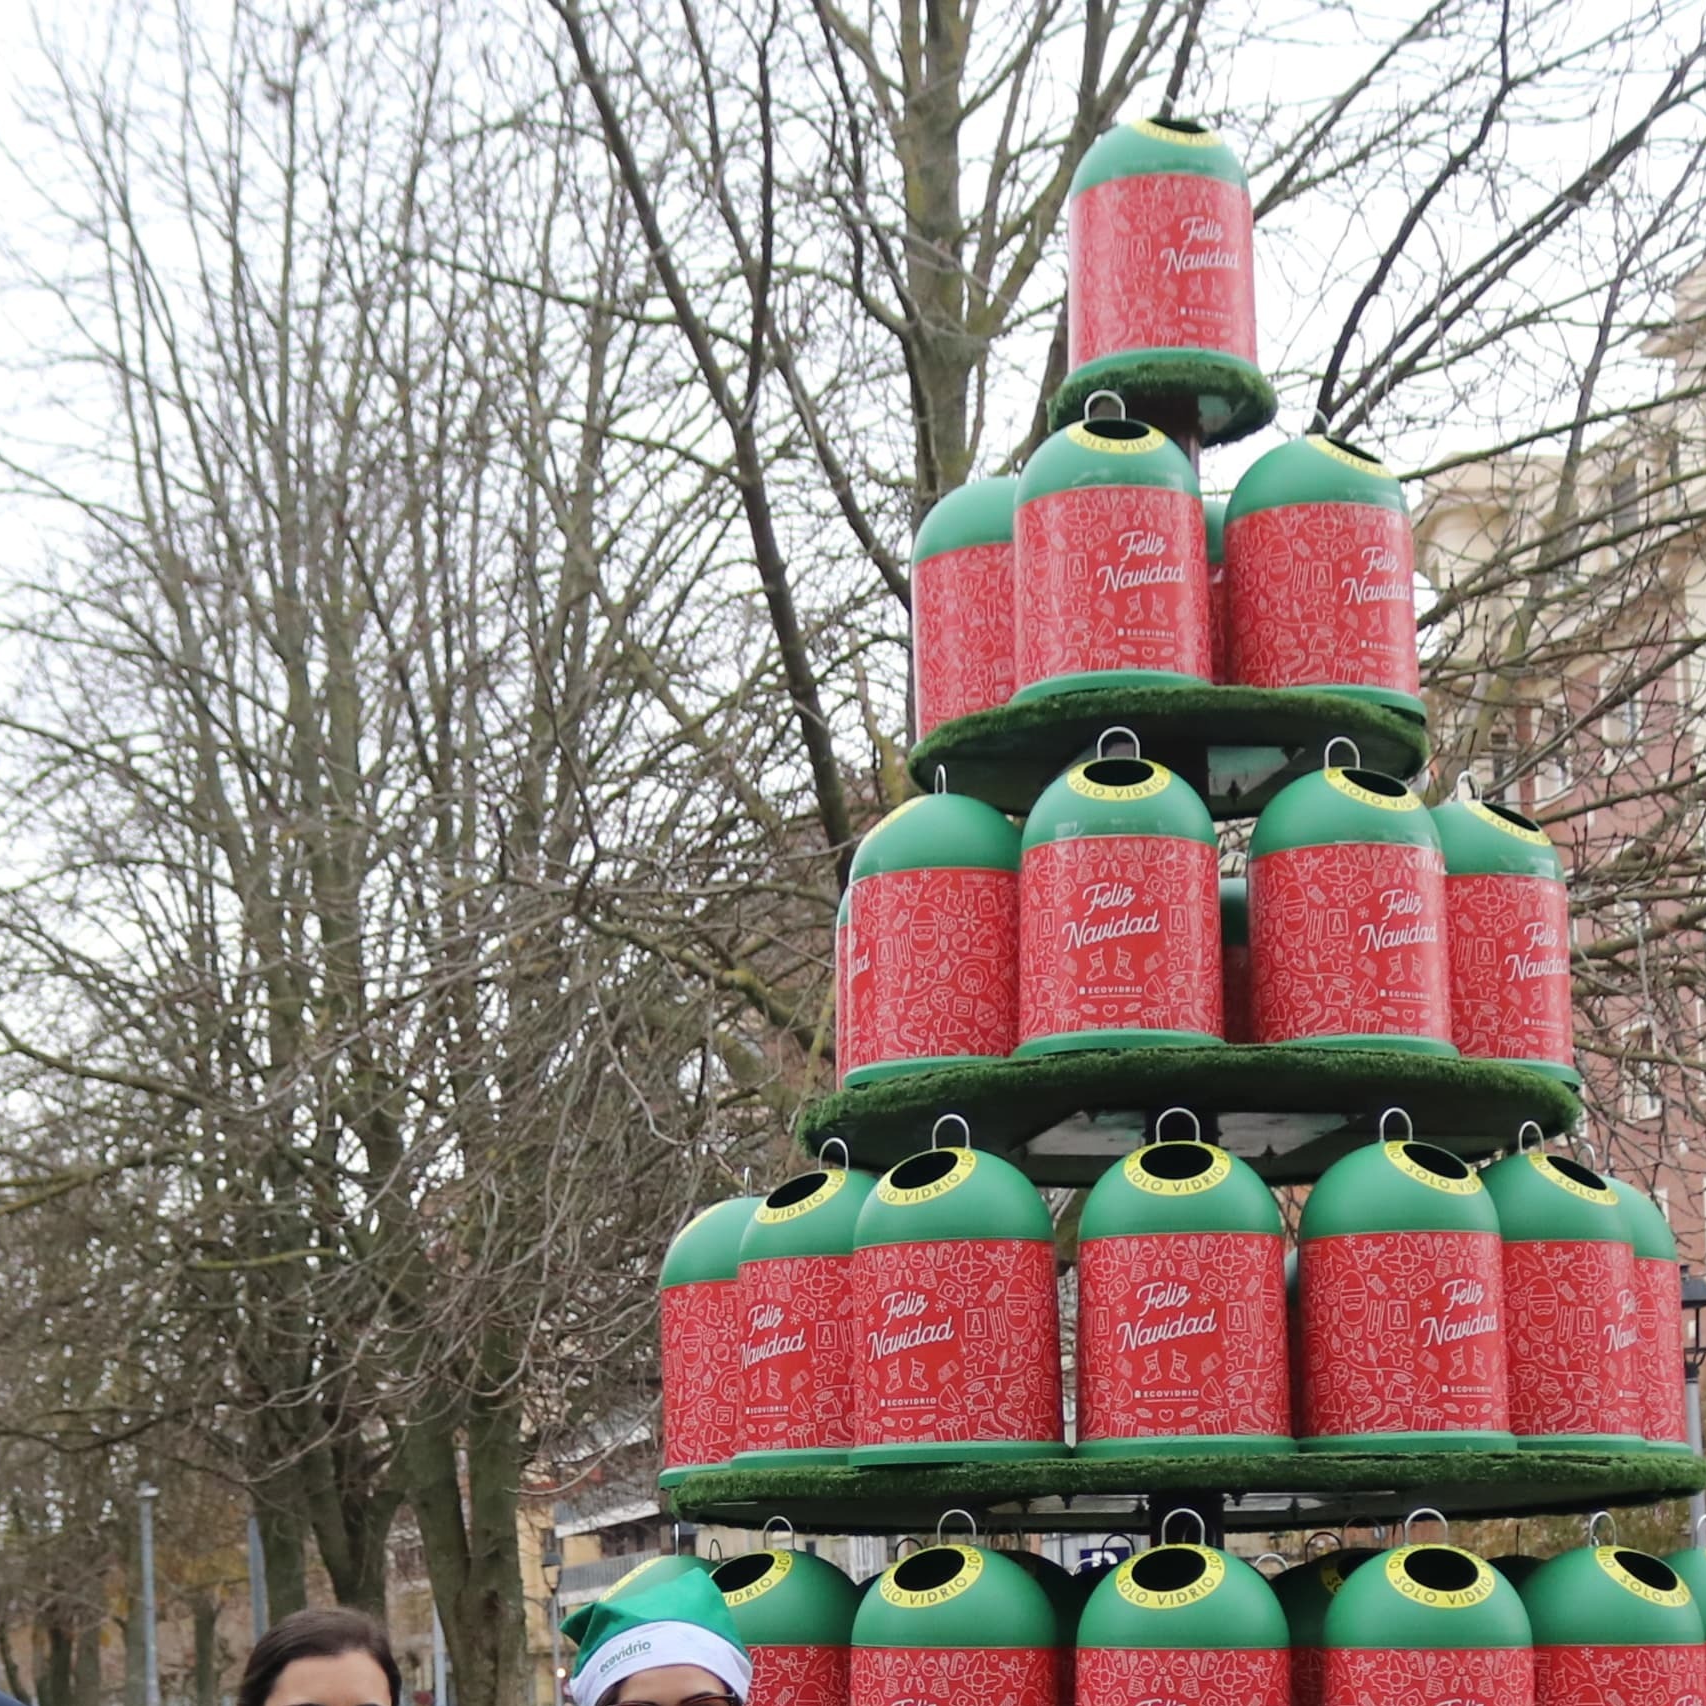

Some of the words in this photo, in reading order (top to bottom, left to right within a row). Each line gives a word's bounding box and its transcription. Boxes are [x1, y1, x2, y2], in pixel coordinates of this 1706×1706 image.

[1181, 216, 1223, 246] Feliz
[1160, 246, 1240, 275] Navidad
[1118, 530, 1166, 561] Feliz
[1361, 546, 1399, 574] Feliz
[1096, 560, 1185, 595] Navidad
[1342, 575, 1411, 605] Navidad
[1082, 882, 1135, 916] Feliz
[1379, 888, 1422, 921] Feliz
[1061, 910, 1160, 951] Navidad
[1358, 921, 1438, 953] Navidad
[1524, 922, 1558, 950] Feliz
[1088, 985, 1143, 994] ECOVIDRIO
[904, 1172, 961, 1203] VIDRIO
[1127, 1165, 1163, 1193] SOLO
[1172, 1164, 1225, 1193] VIDRIO
[1405, 1161, 1450, 1191] SOLO
[770, 1190, 824, 1222] VIDRIO
[881, 1290, 929, 1327] Feliz
[1136, 1281, 1191, 1318] Feliz
[1442, 1279, 1484, 1312] Feliz
[747, 1302, 784, 1336] Feliz
[1117, 1309, 1217, 1353] Navidad
[1420, 1312, 1498, 1349] Navidad
[740, 1329, 806, 1372] Navidad
[867, 1316, 955, 1363] Navidad
[1142, 1388, 1199, 1399] ECOVIDRIO
[909, 1575, 968, 1606] VIDRIO
[1118, 1575, 1148, 1605] SOLO
[1157, 1575, 1216, 1606] VIDRIO
[1394, 1574, 1438, 1605] SOLO
[1448, 1574, 1494, 1605] VIDRIO
[1619, 1573, 1665, 1602] SOLO
[600, 1640, 651, 1672] ecovidrio
